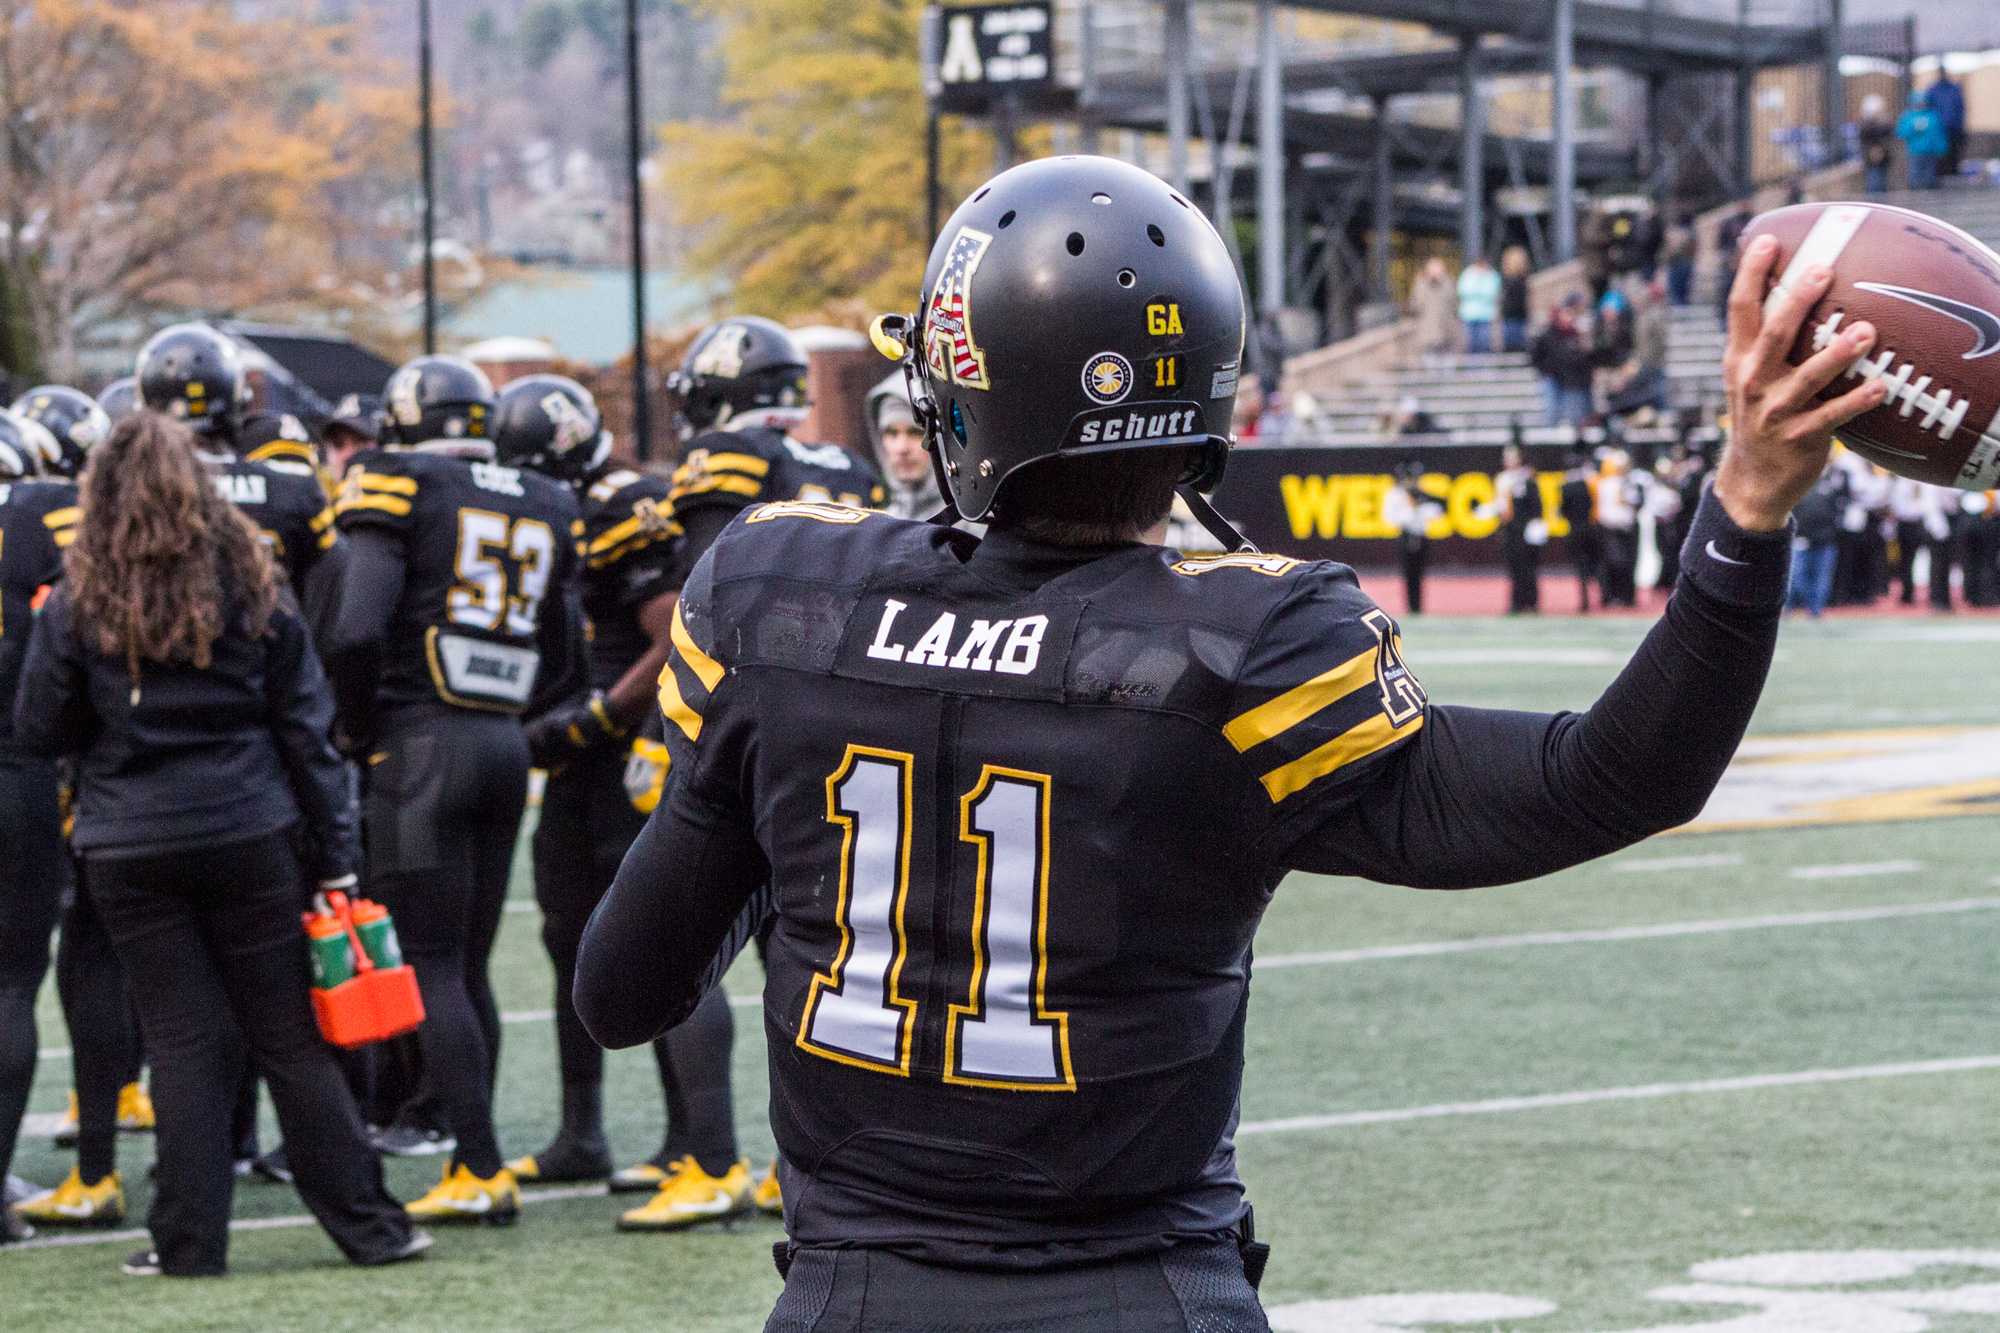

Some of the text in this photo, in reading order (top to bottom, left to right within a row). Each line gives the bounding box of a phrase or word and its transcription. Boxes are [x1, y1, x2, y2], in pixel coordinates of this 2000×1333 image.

[1147, 303, 1184, 336] GA
[1155, 356, 1177, 388] 11
[1080, 410, 1196, 443] schutt
[447, 506, 556, 637] 53
[867, 598, 1050, 676] LAMB
[796, 743, 1078, 1093] 11
